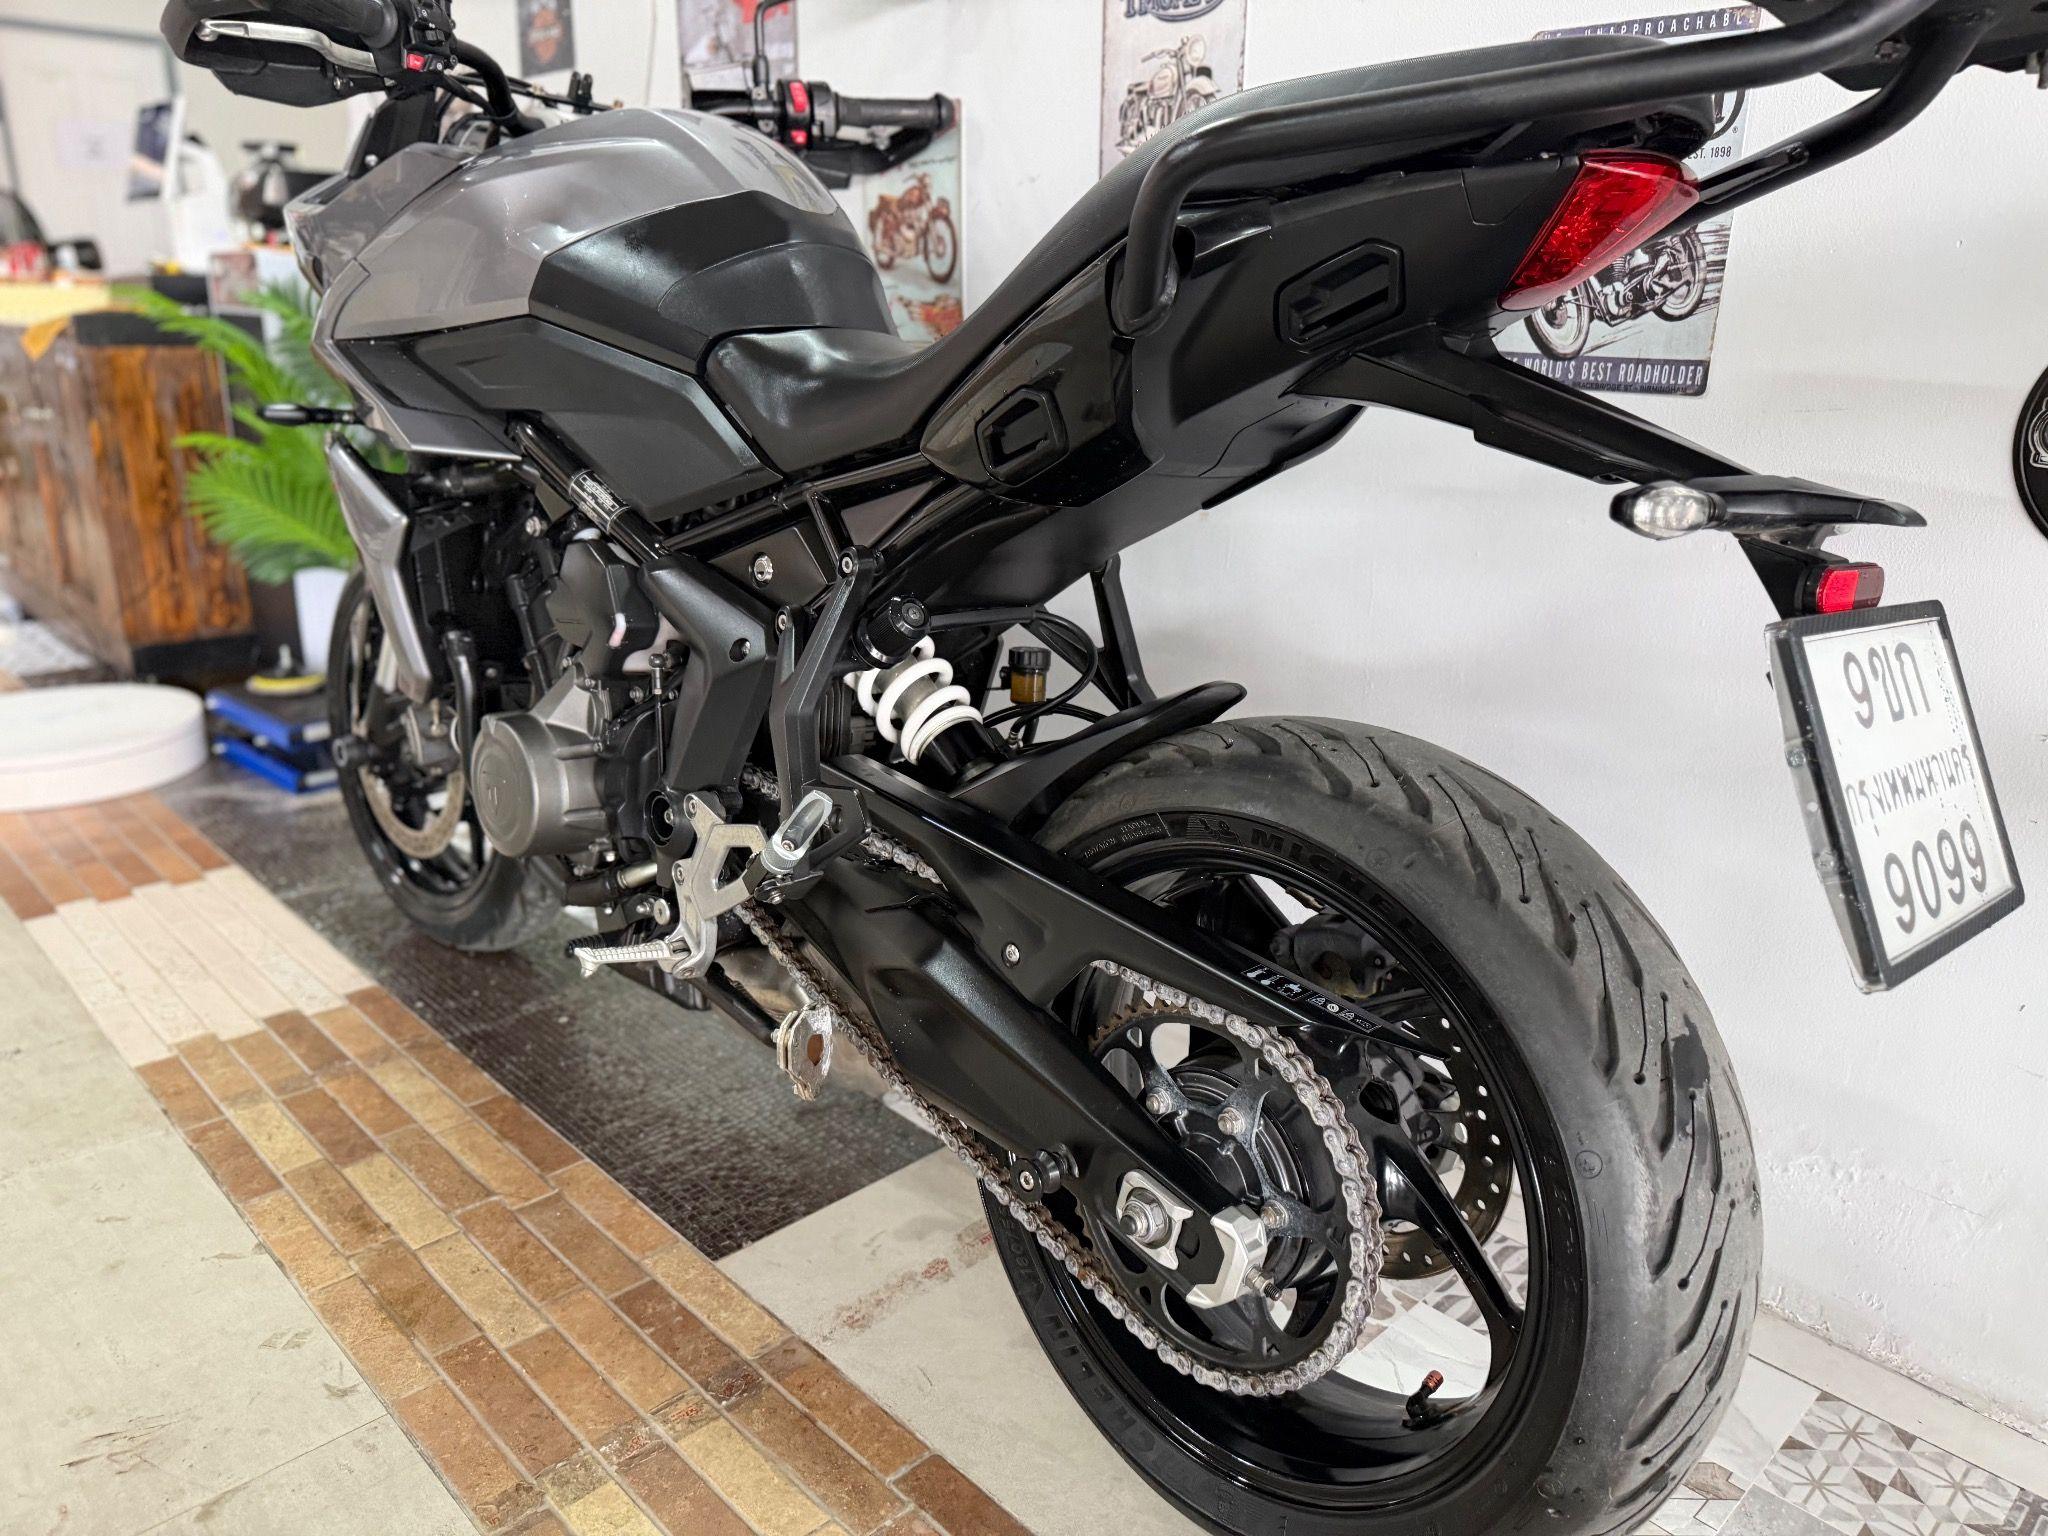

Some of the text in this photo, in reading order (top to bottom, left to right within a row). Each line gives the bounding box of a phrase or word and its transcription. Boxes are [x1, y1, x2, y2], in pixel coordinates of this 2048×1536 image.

[1711, 145, 1732, 158] 1898
[1581, 361, 1613, 381] BEST
[1618, 363, 1703, 386] ROADHOLDER
[1843, 642, 1931, 729] 9ขก
[1845, 744, 1975, 837] กรุงเทพมหานคร
[1884, 819, 1987, 935] 9099
